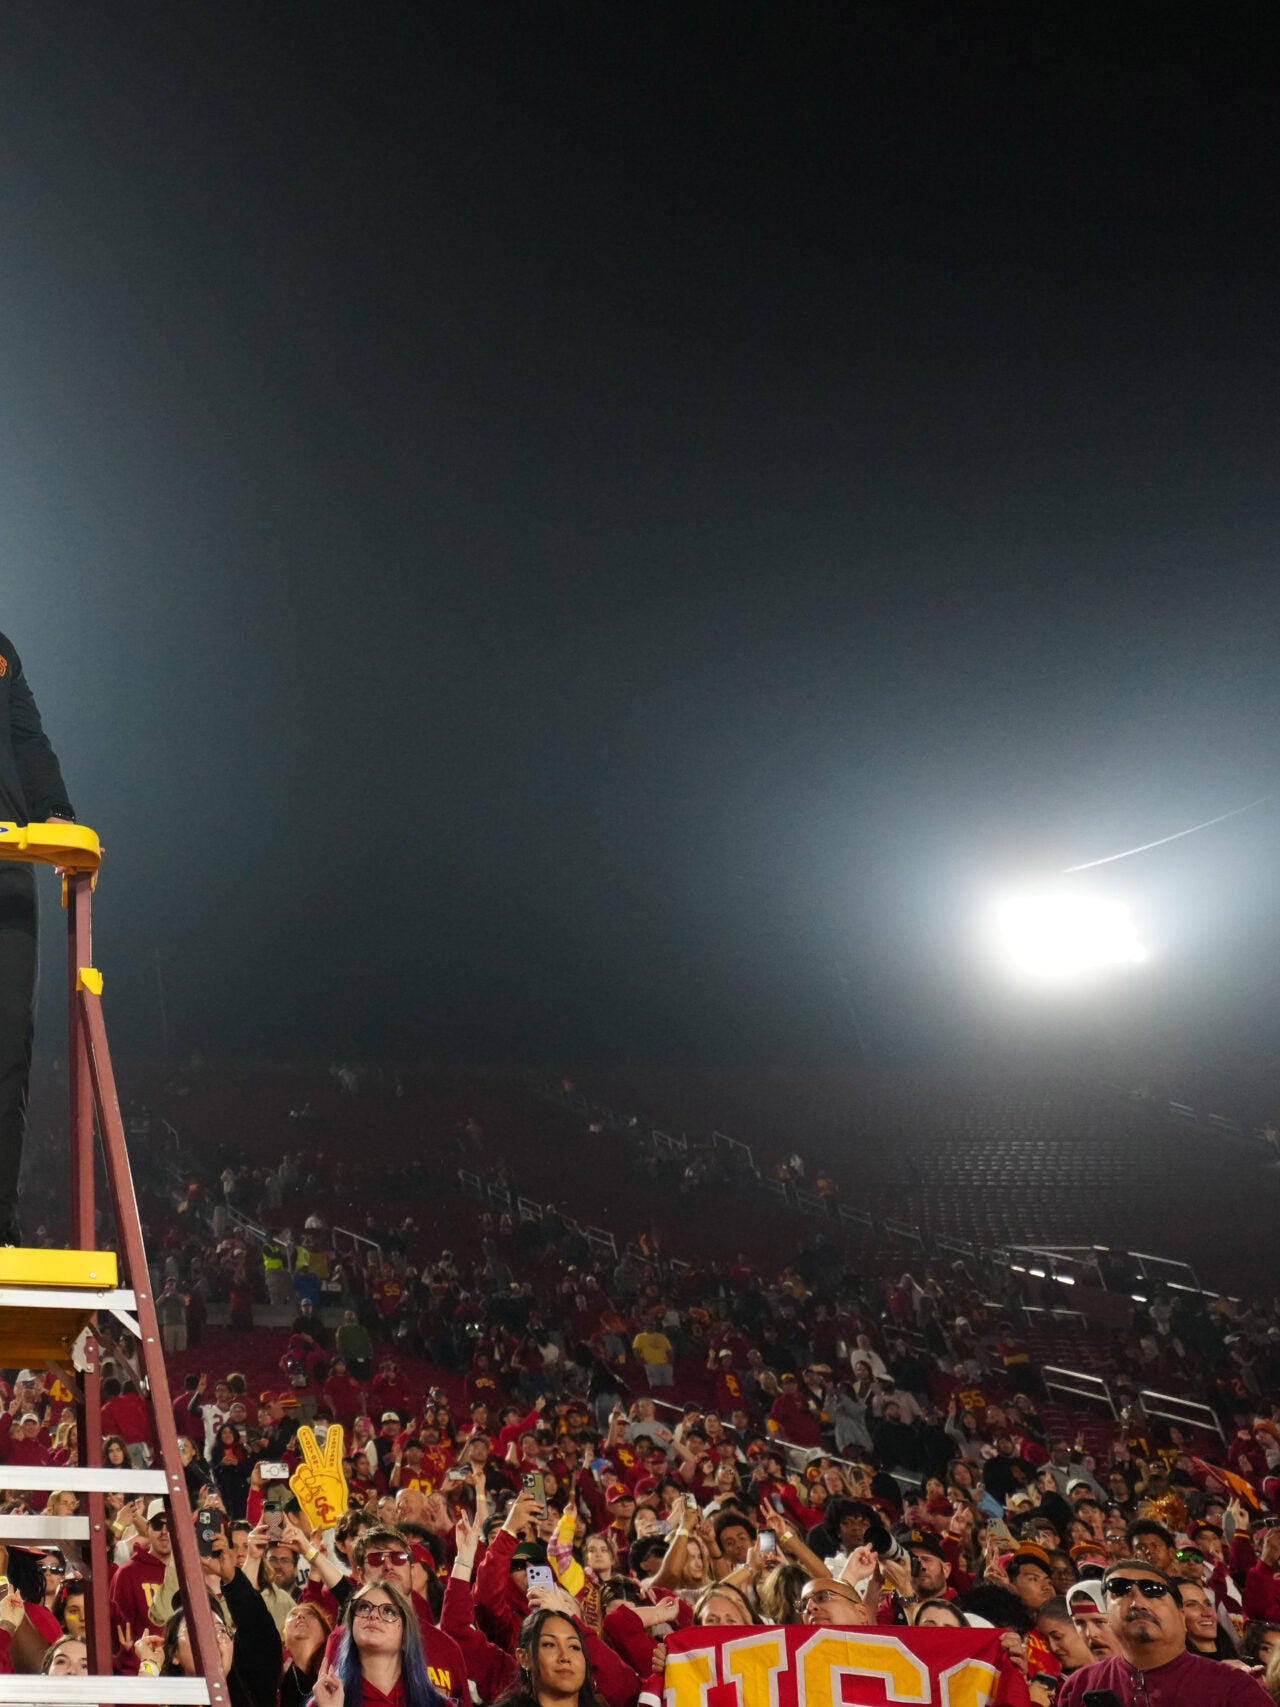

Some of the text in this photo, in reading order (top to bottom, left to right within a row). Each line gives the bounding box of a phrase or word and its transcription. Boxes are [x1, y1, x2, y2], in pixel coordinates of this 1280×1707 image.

[49, 1379, 73, 1403] 43
[314, 1496, 337, 1524] SC
[664, 1628, 1002, 1707] US
